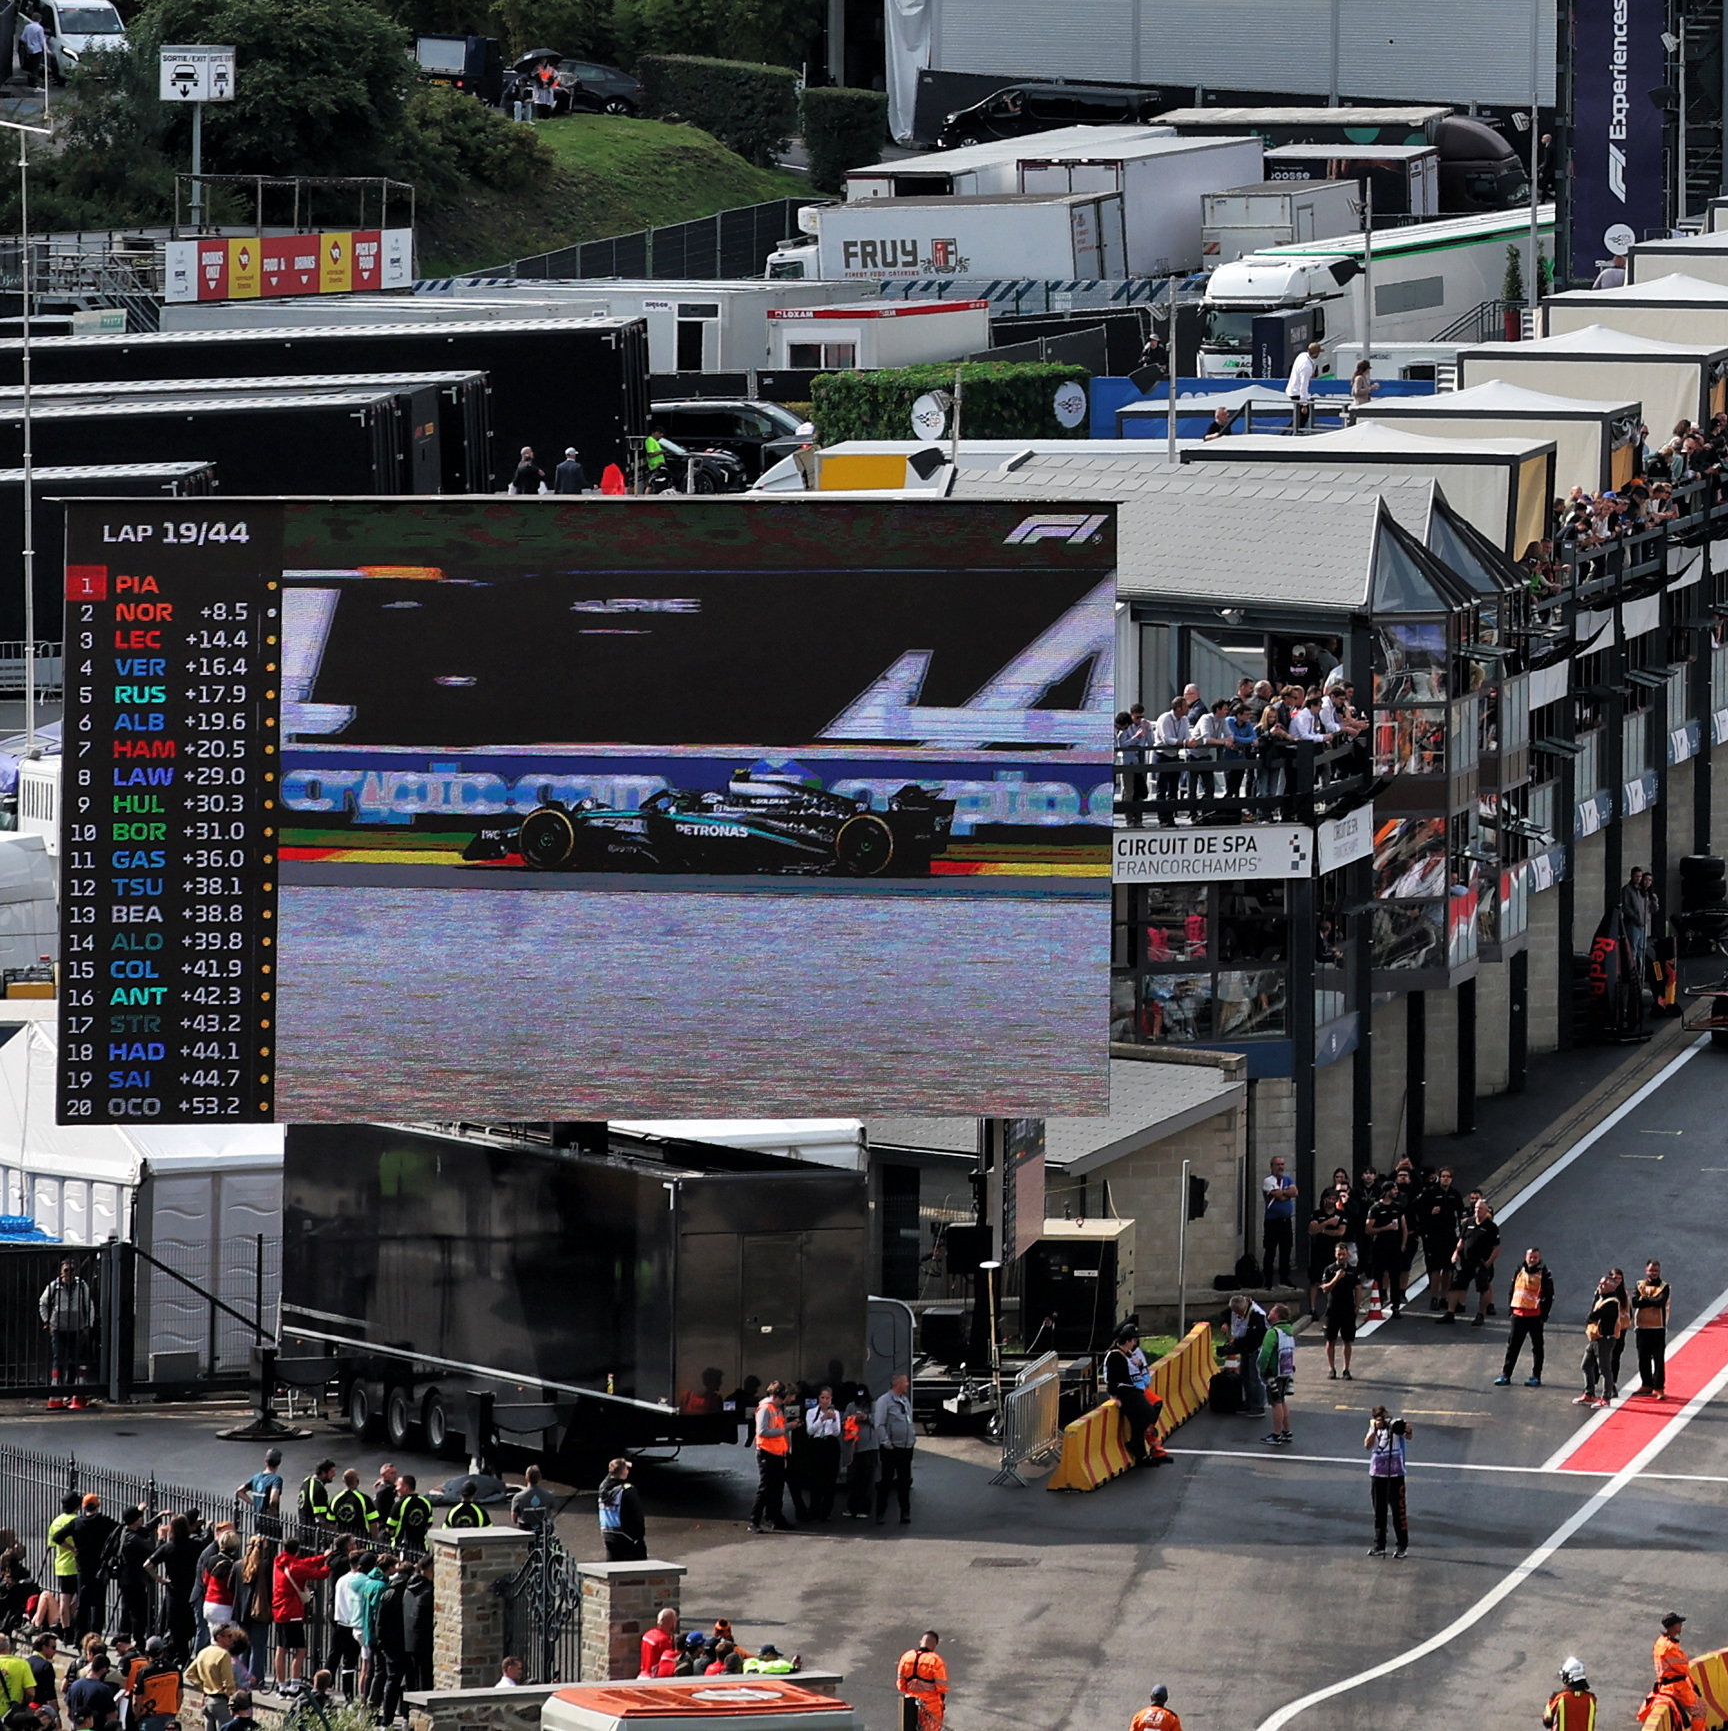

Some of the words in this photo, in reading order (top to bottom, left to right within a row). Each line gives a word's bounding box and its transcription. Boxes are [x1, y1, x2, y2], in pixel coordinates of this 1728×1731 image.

[842, 239, 918, 268] FRUY
[782, 310, 814, 318] LOXAM
[103, 524, 152, 542] LAP
[163, 522, 249, 545] 19/44
[80, 577, 94, 594] 1
[115, 574, 160, 594] PIA
[80, 605, 95, 623] 2
[115, 602, 174, 623] NOR
[200, 602, 248, 621] +8.5
[79, 632, 93, 650] 3
[114, 629, 162, 650] LEC
[185, 629, 249, 649] +14.4
[79, 660, 93, 677] 4
[114, 658, 167, 677] VER
[185, 657, 248, 676] +16.4
[78, 687, 93, 704] 5
[114, 685, 167, 704] RUS
[184, 685, 246, 704] +17.9
[78, 714, 92, 732] 6
[113, 712, 165, 732] ALB
[184, 712, 246, 731] +19.6
[77, 742, 92, 759] 7
[113, 739, 176, 759] HAM
[184, 739, 246, 759] +20.5
[78, 769, 91, 786] 8
[113, 767, 175, 787] LAW
[183, 766, 246, 785] +29.0
[78, 796, 90, 814] 9
[113, 794, 165, 814] HUL
[183, 794, 244, 813] +30.3
[71, 824, 96, 842] 10
[112, 822, 167, 841] BOR
[183, 821, 245, 840] +31.0
[675, 823, 749, 838] PETRONAS
[1117, 837, 1188, 856] CIRCUIT
[1194, 837, 1217, 854] DE
[1223, 835, 1257, 853] SPA
[70, 851, 96, 869] 11
[111, 850, 166, 869] GAS
[182, 849, 245, 868] +36.0
[1117, 858, 1257, 876] FRANCORCHAMPS
[69, 879, 96, 897] 12
[111, 877, 163, 897] TSU
[182, 876, 243, 896] +38.1
[69, 906, 96, 924] 13
[111, 905, 164, 923] BEA
[182, 904, 243, 923] +38.8
[69, 934, 95, 952] 14
[110, 932, 164, 951] ALO
[181, 931, 243, 951] +39.8
[69, 961, 94, 979] 15
[110, 959, 160, 979] COL
[181, 959, 242, 978] +41.9
[68, 989, 94, 1007] 16
[109, 986, 168, 1006] ANT
[180, 986, 241, 1005] +42.3
[68, 1016, 94, 1034] 17
[110, 1014, 161, 1033] STR
[180, 1014, 241, 1033] +43.2
[67, 1043, 93, 1061] 18
[108, 1042, 166, 1061] HAD
[180, 1041, 240, 1060] +44.1
[67, 1071, 93, 1089] 19
[108, 1070, 151, 1089] SAI
[179, 1069, 240, 1087] +44.7
[66, 1099, 92, 1116] 20
[108, 1097, 161, 1116] OCO
[178, 1096, 240, 1115] +53.2
